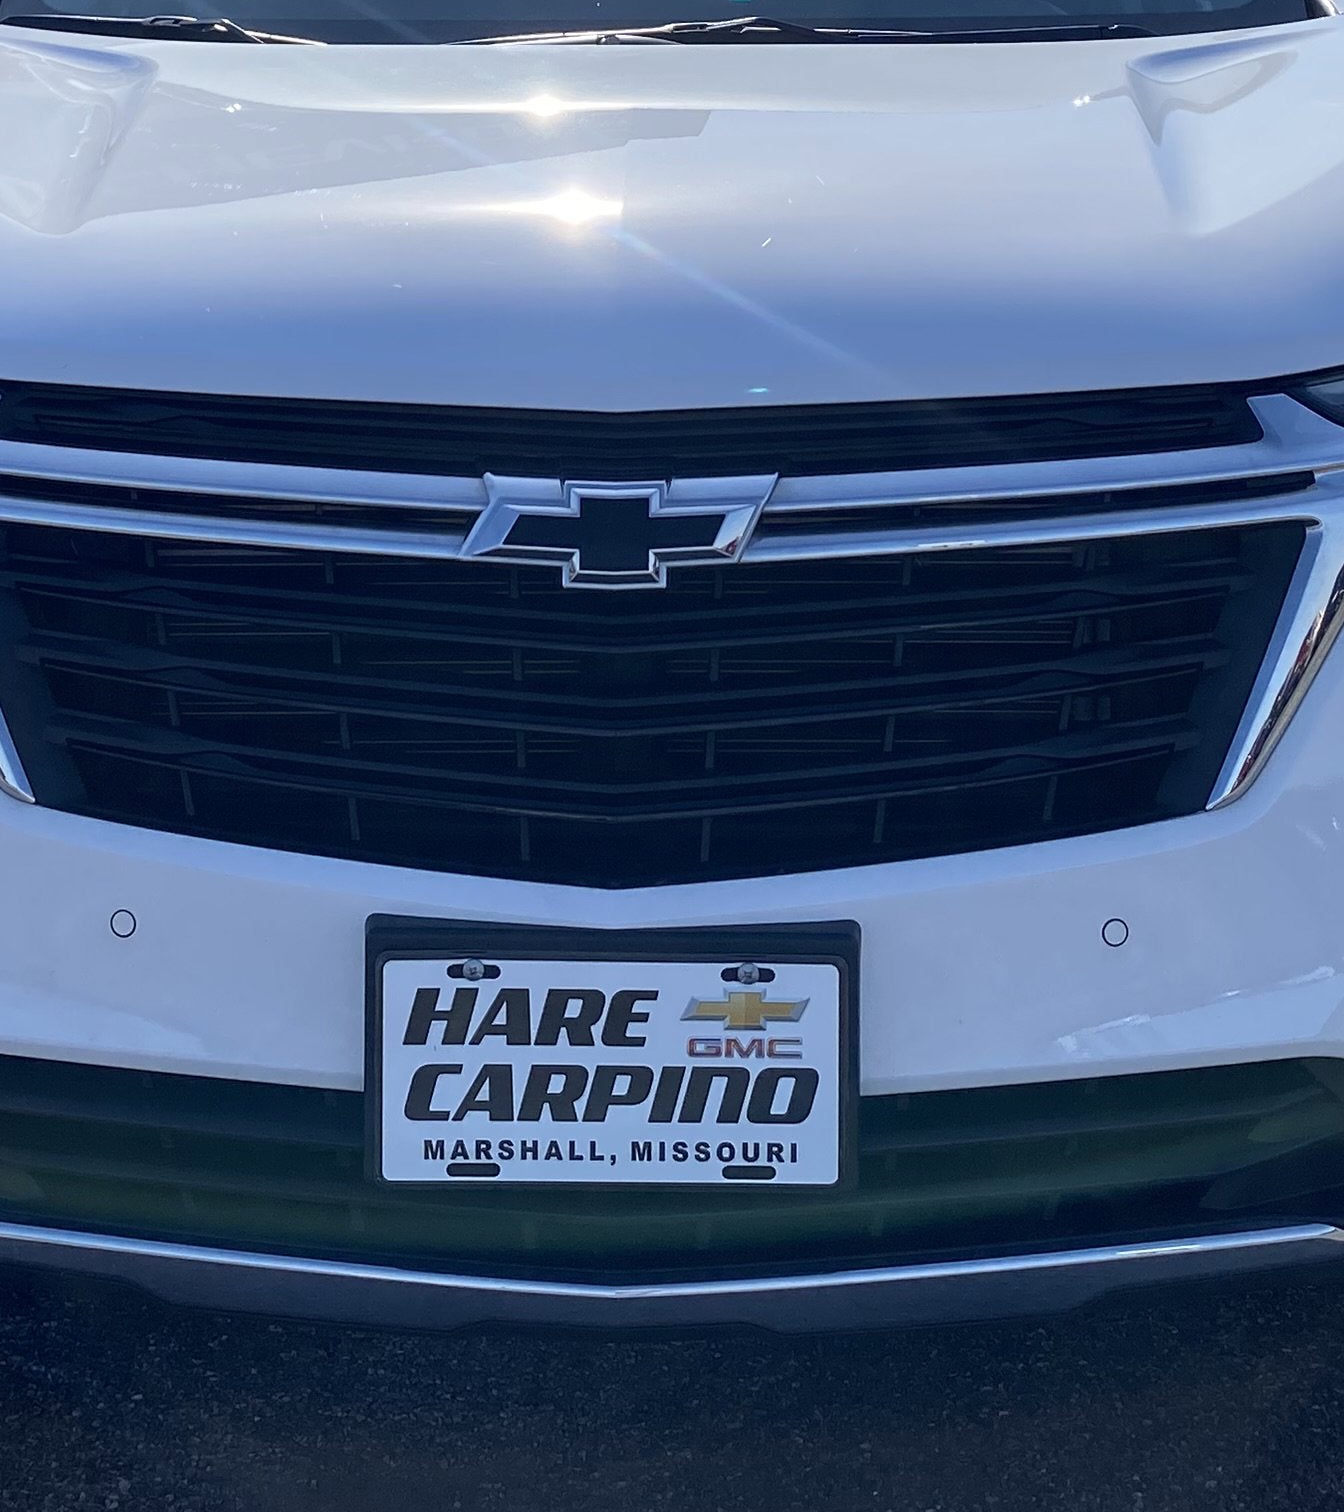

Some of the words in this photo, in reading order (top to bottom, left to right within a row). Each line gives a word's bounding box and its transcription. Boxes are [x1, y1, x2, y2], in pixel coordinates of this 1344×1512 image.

[402, 988, 659, 1047] HARE
[687, 1037, 803, 1059] GMC
[404, 1064, 819, 1124] CARPINO
[423, 1140, 617, 1166] MARSHALL,
[631, 1141, 799, 1164] MISSOURI
